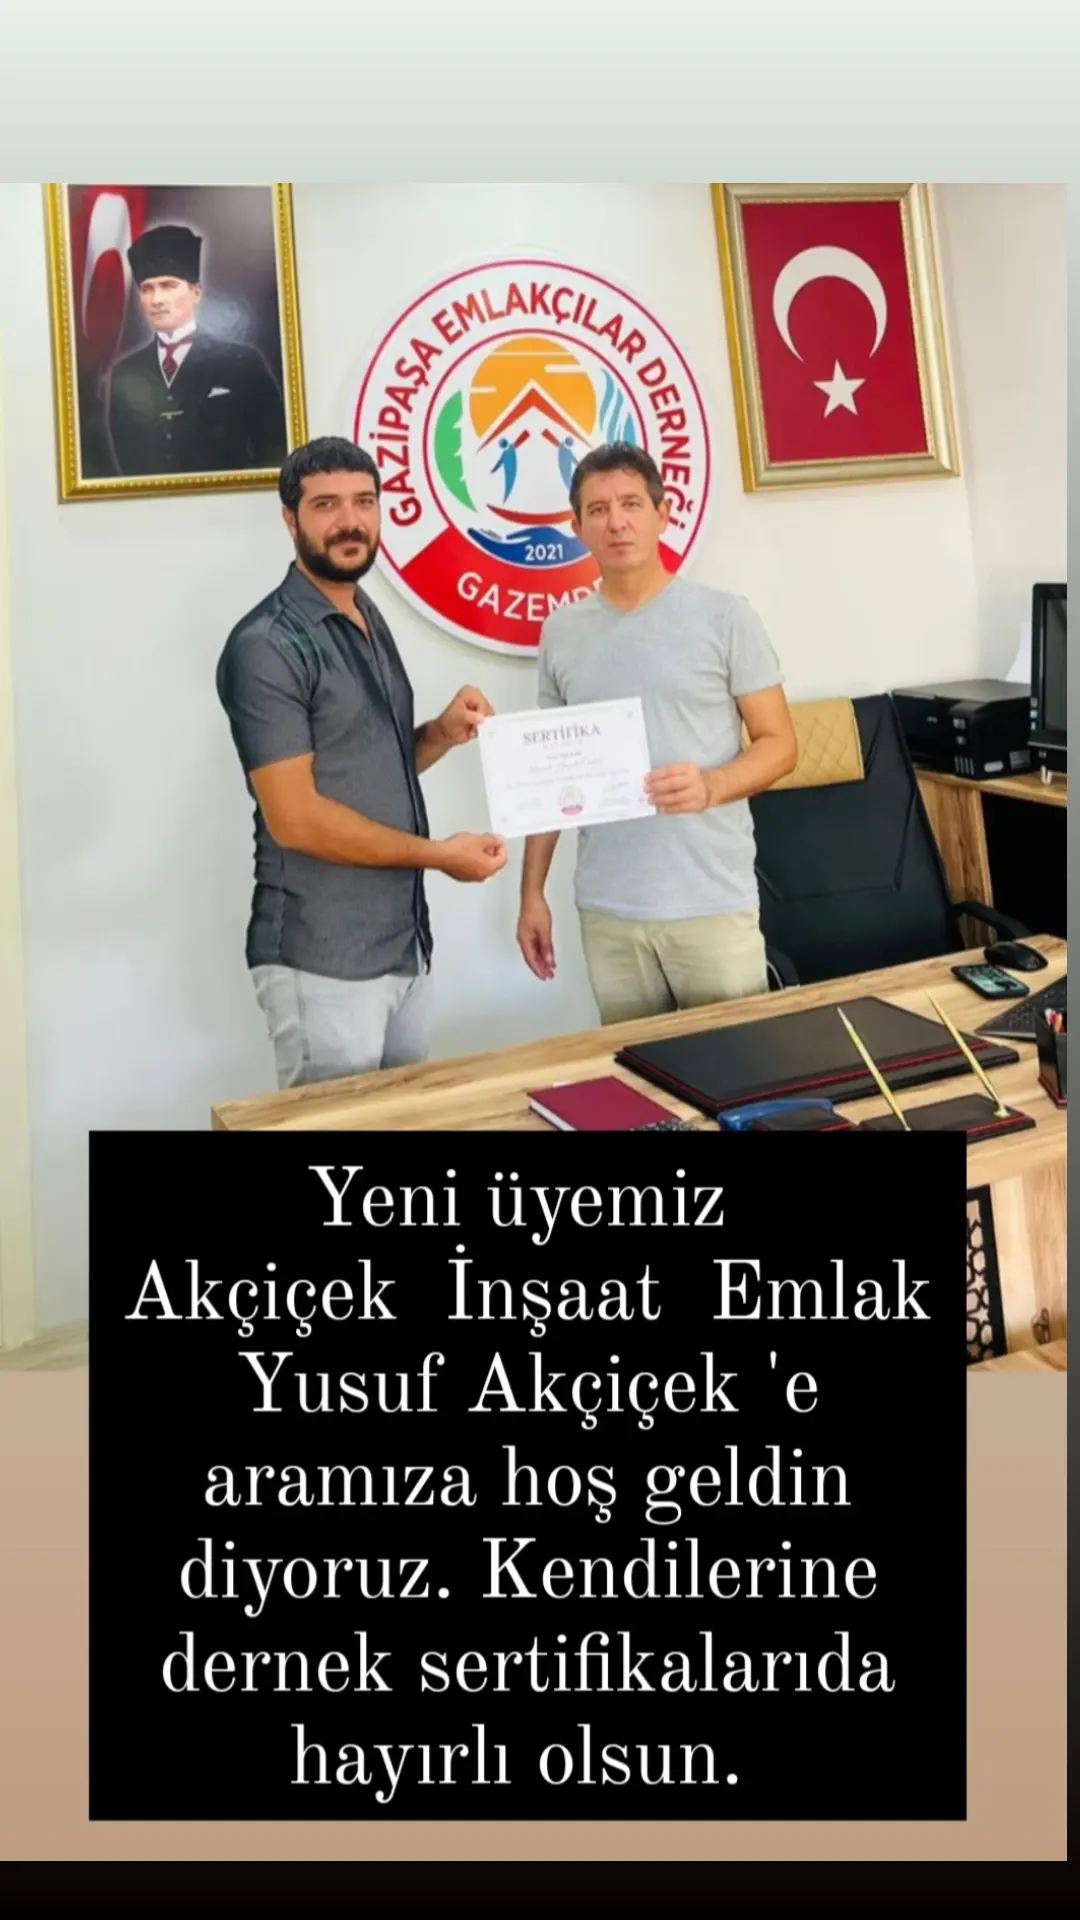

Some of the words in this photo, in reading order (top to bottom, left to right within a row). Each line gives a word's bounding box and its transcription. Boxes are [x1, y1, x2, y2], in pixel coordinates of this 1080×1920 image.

[368, 336, 443, 528] GAZİPAŞA
[430, 281, 647, 364] EMLAKÇILAR
[524, 543, 565, 562] 2021
[456, 575, 604, 622] GAZEMD
[522, 722, 601, 747] SERTİFİKA
